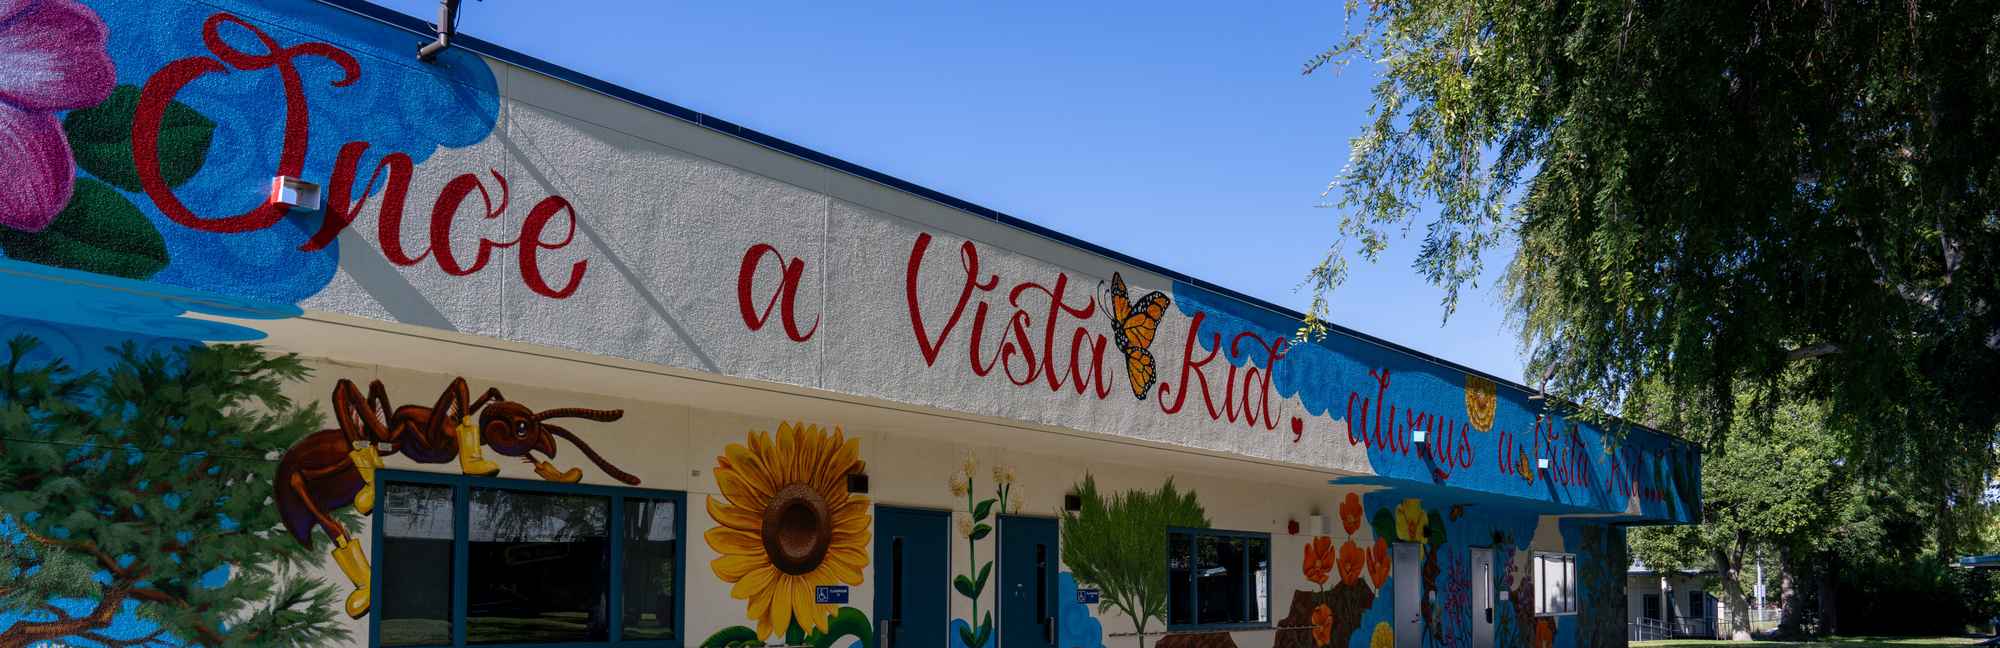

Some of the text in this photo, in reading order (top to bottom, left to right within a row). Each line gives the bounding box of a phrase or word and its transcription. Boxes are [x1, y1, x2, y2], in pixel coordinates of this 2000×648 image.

[132, 12, 588, 299] Once
[737, 243, 821, 342] a
[906, 232, 1114, 401] Vista
[1157, 310, 1305, 442] Kid,
[1347, 369, 1476, 480] always
[1534, 416, 1590, 488] Vista
